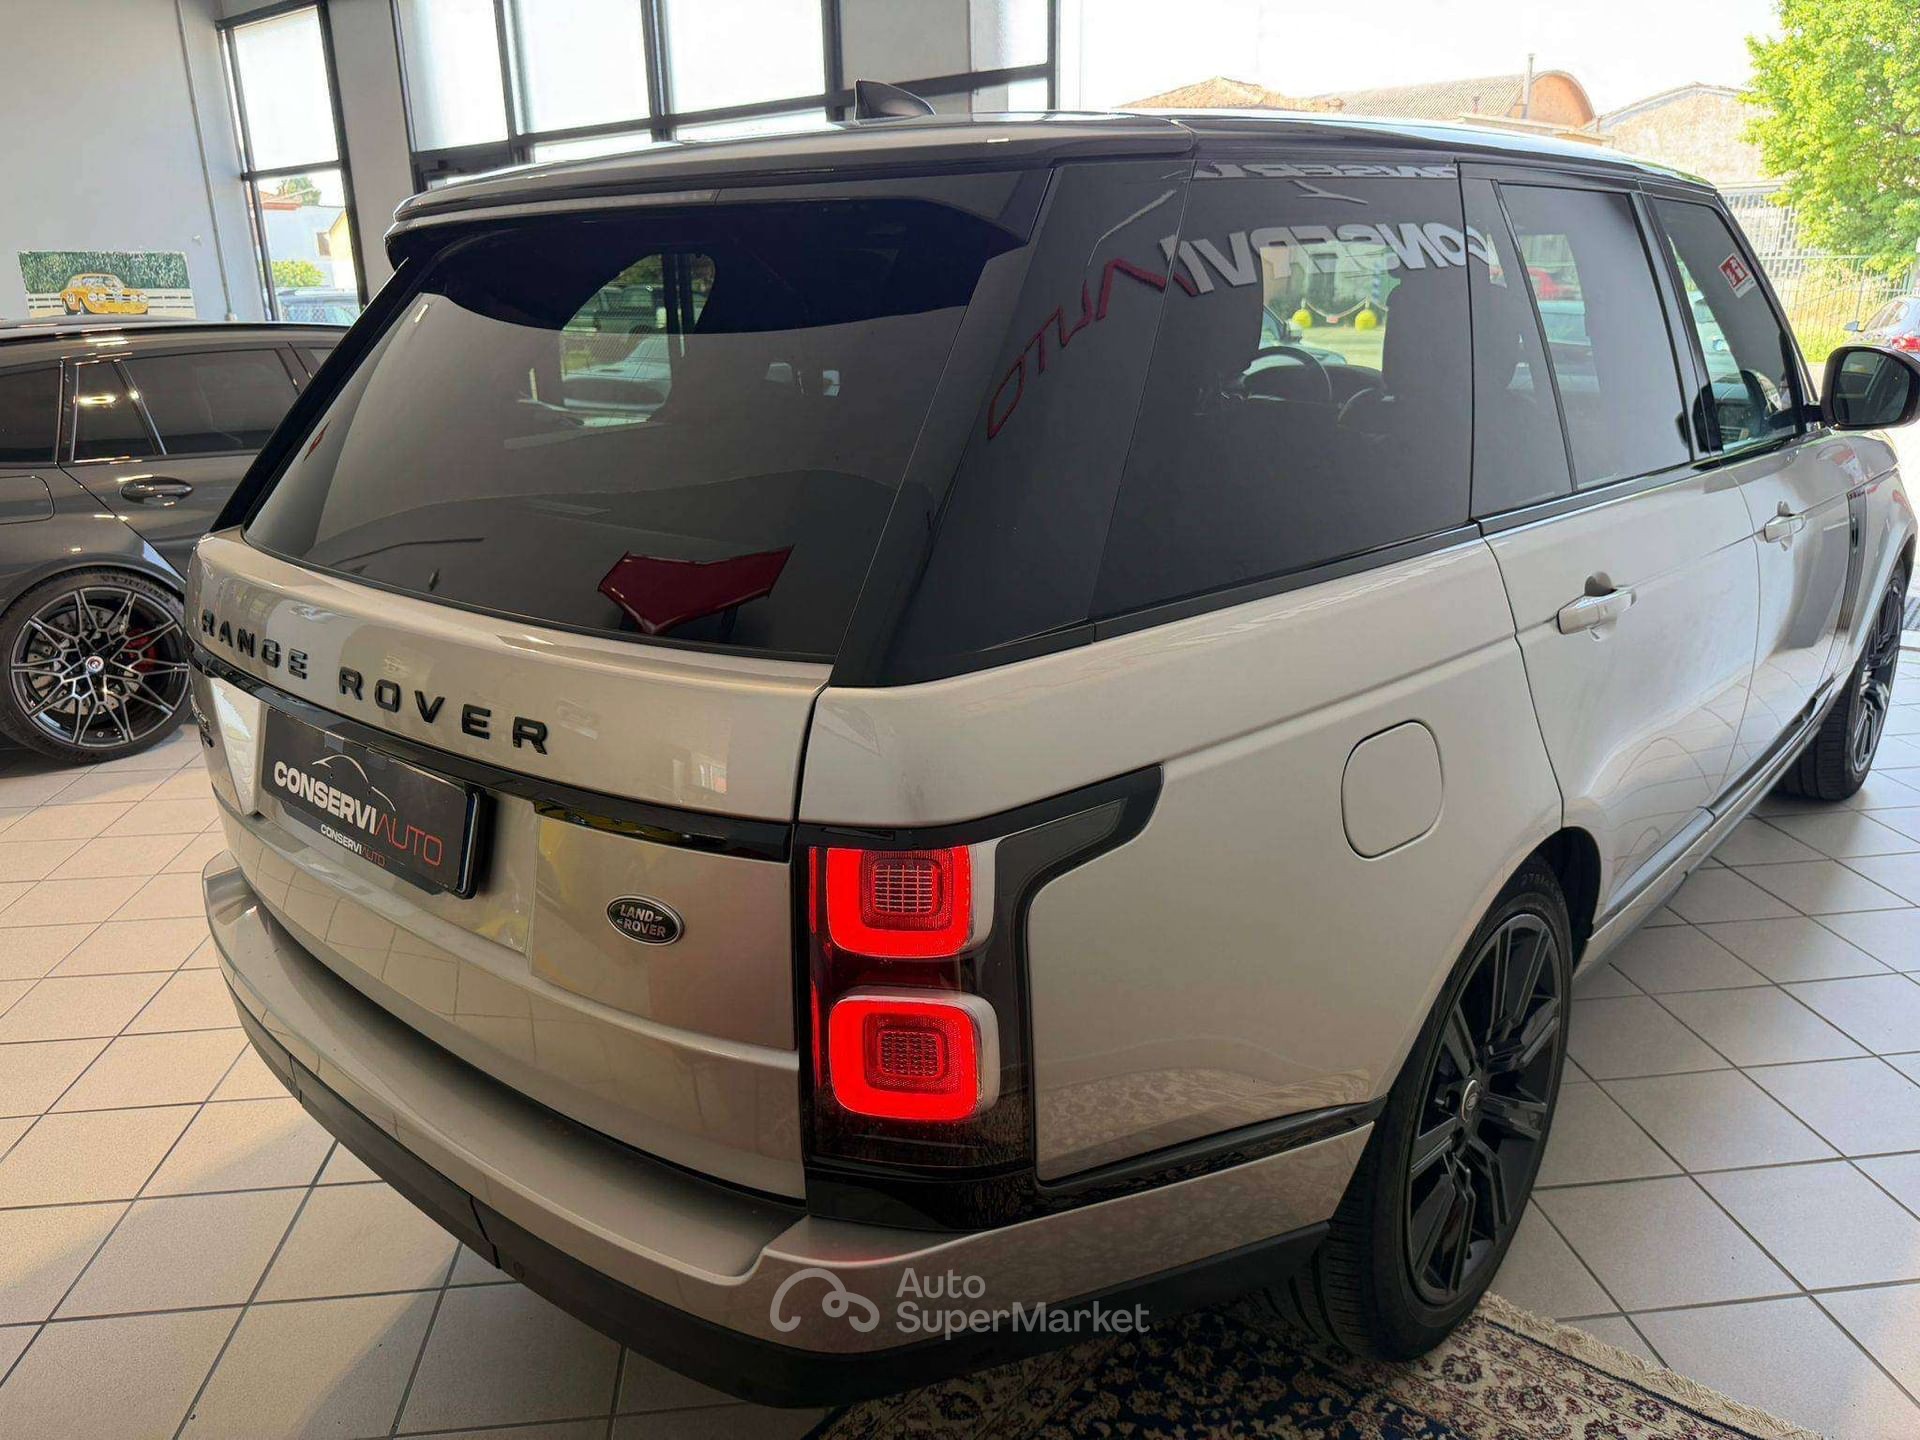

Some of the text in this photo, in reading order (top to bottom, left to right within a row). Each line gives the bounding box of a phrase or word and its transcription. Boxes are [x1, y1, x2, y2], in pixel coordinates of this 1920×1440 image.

[201, 608, 549, 755] RANGE ROVER
[274, 761, 443, 867] CONSERVIAUTO
[320, 823, 386, 868] CONSERVIAUTO
[619, 904, 655, 922] LAND
[622, 918, 667, 938] ROVER
